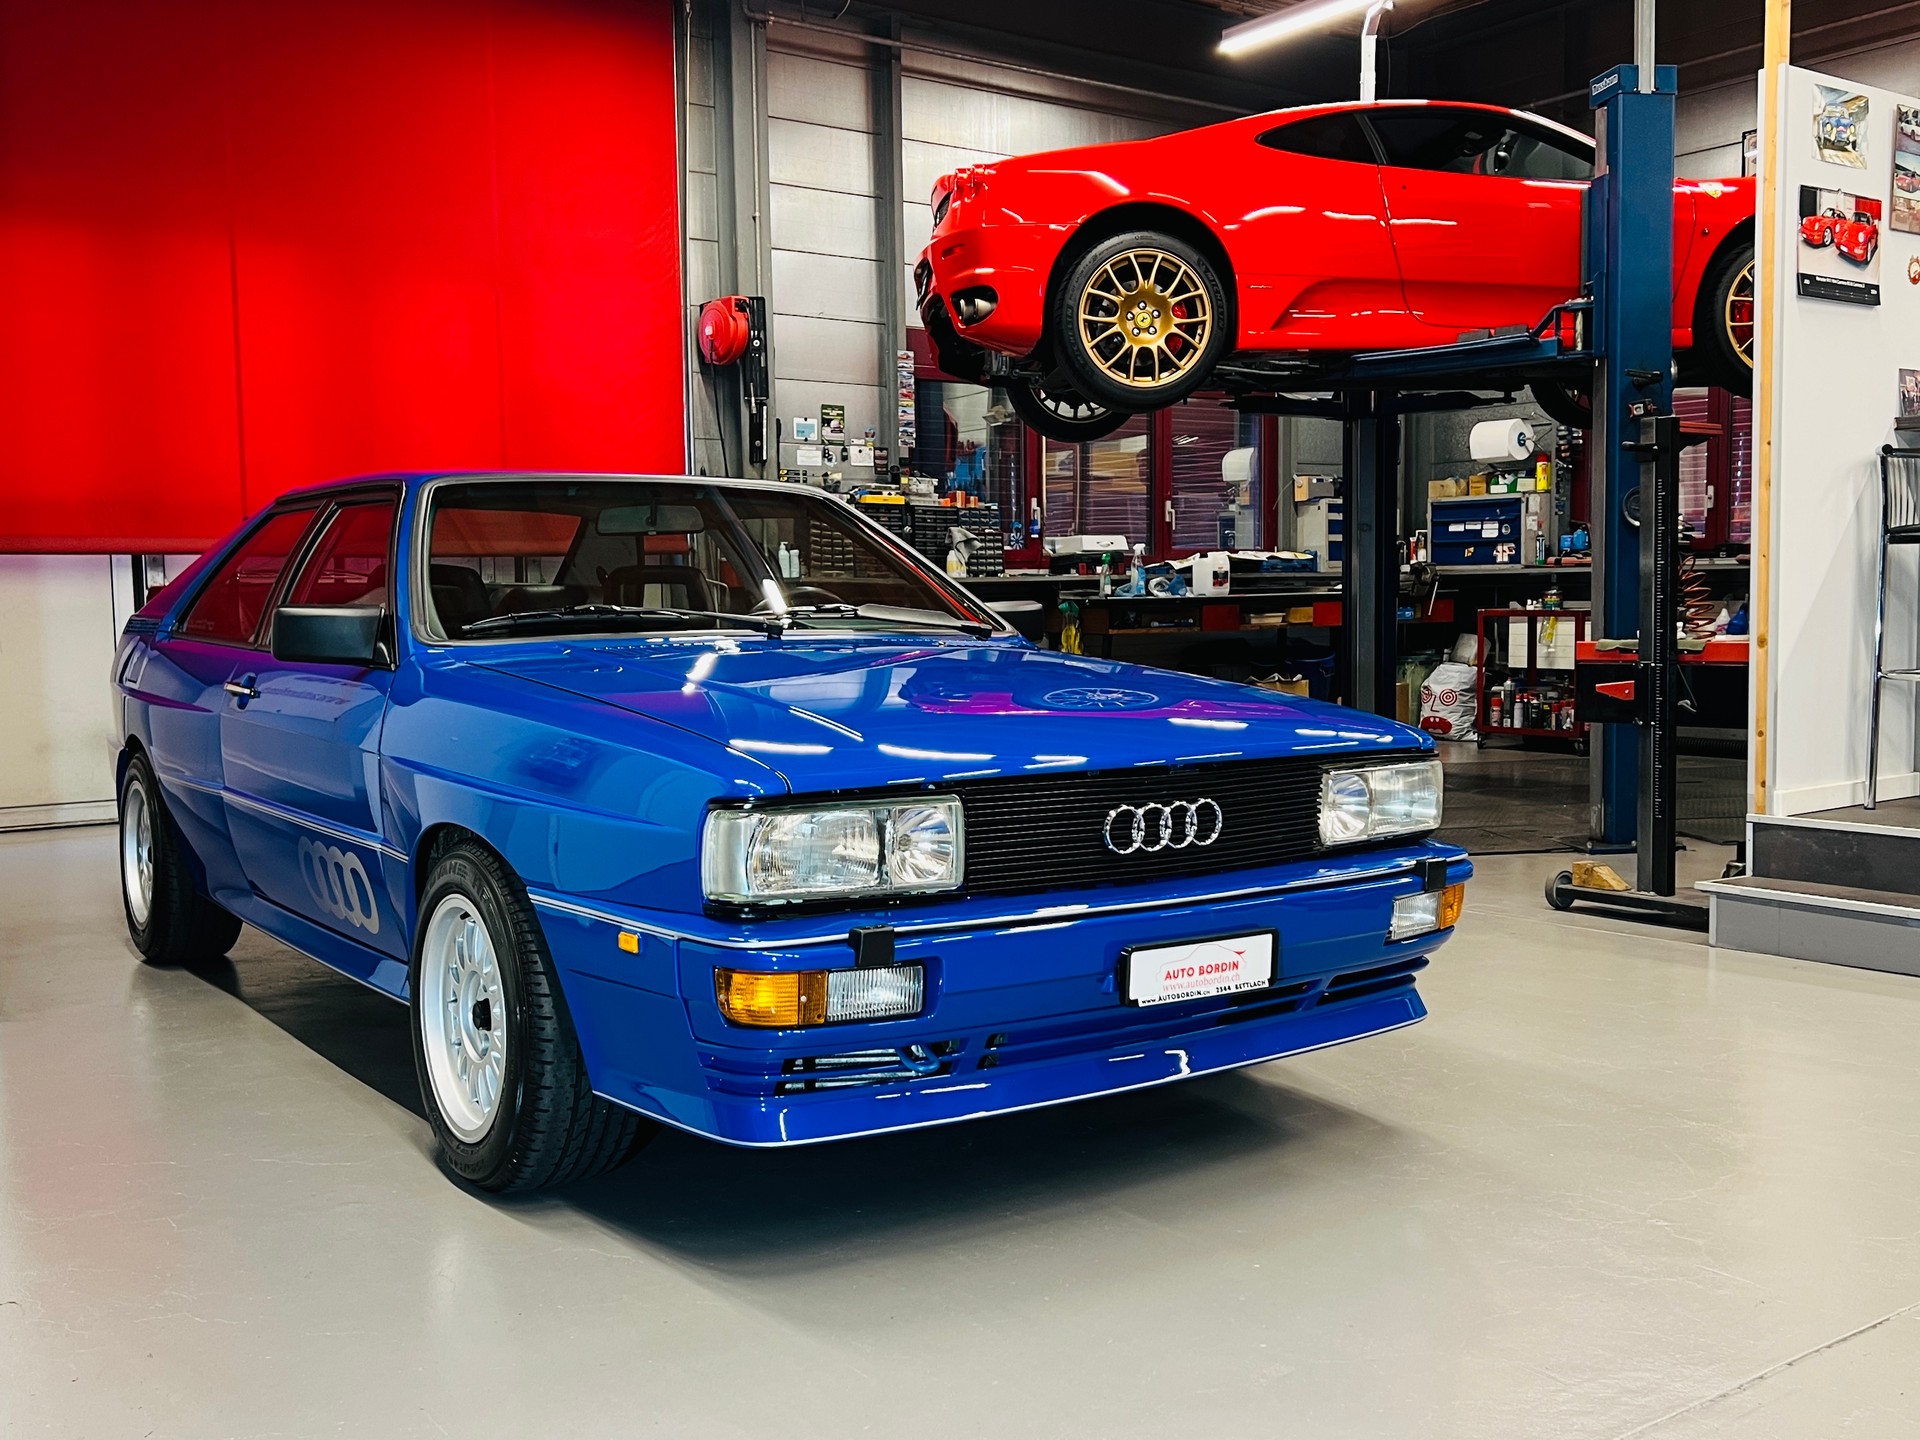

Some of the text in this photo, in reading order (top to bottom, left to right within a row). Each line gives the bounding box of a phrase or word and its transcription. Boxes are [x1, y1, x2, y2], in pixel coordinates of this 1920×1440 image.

[1164, 960, 1239, 981] AUTO BORDIN
[1163, 972, 1240, 991] www.autobordin.ch
[1235, 980, 1266, 990] BETTLACH
